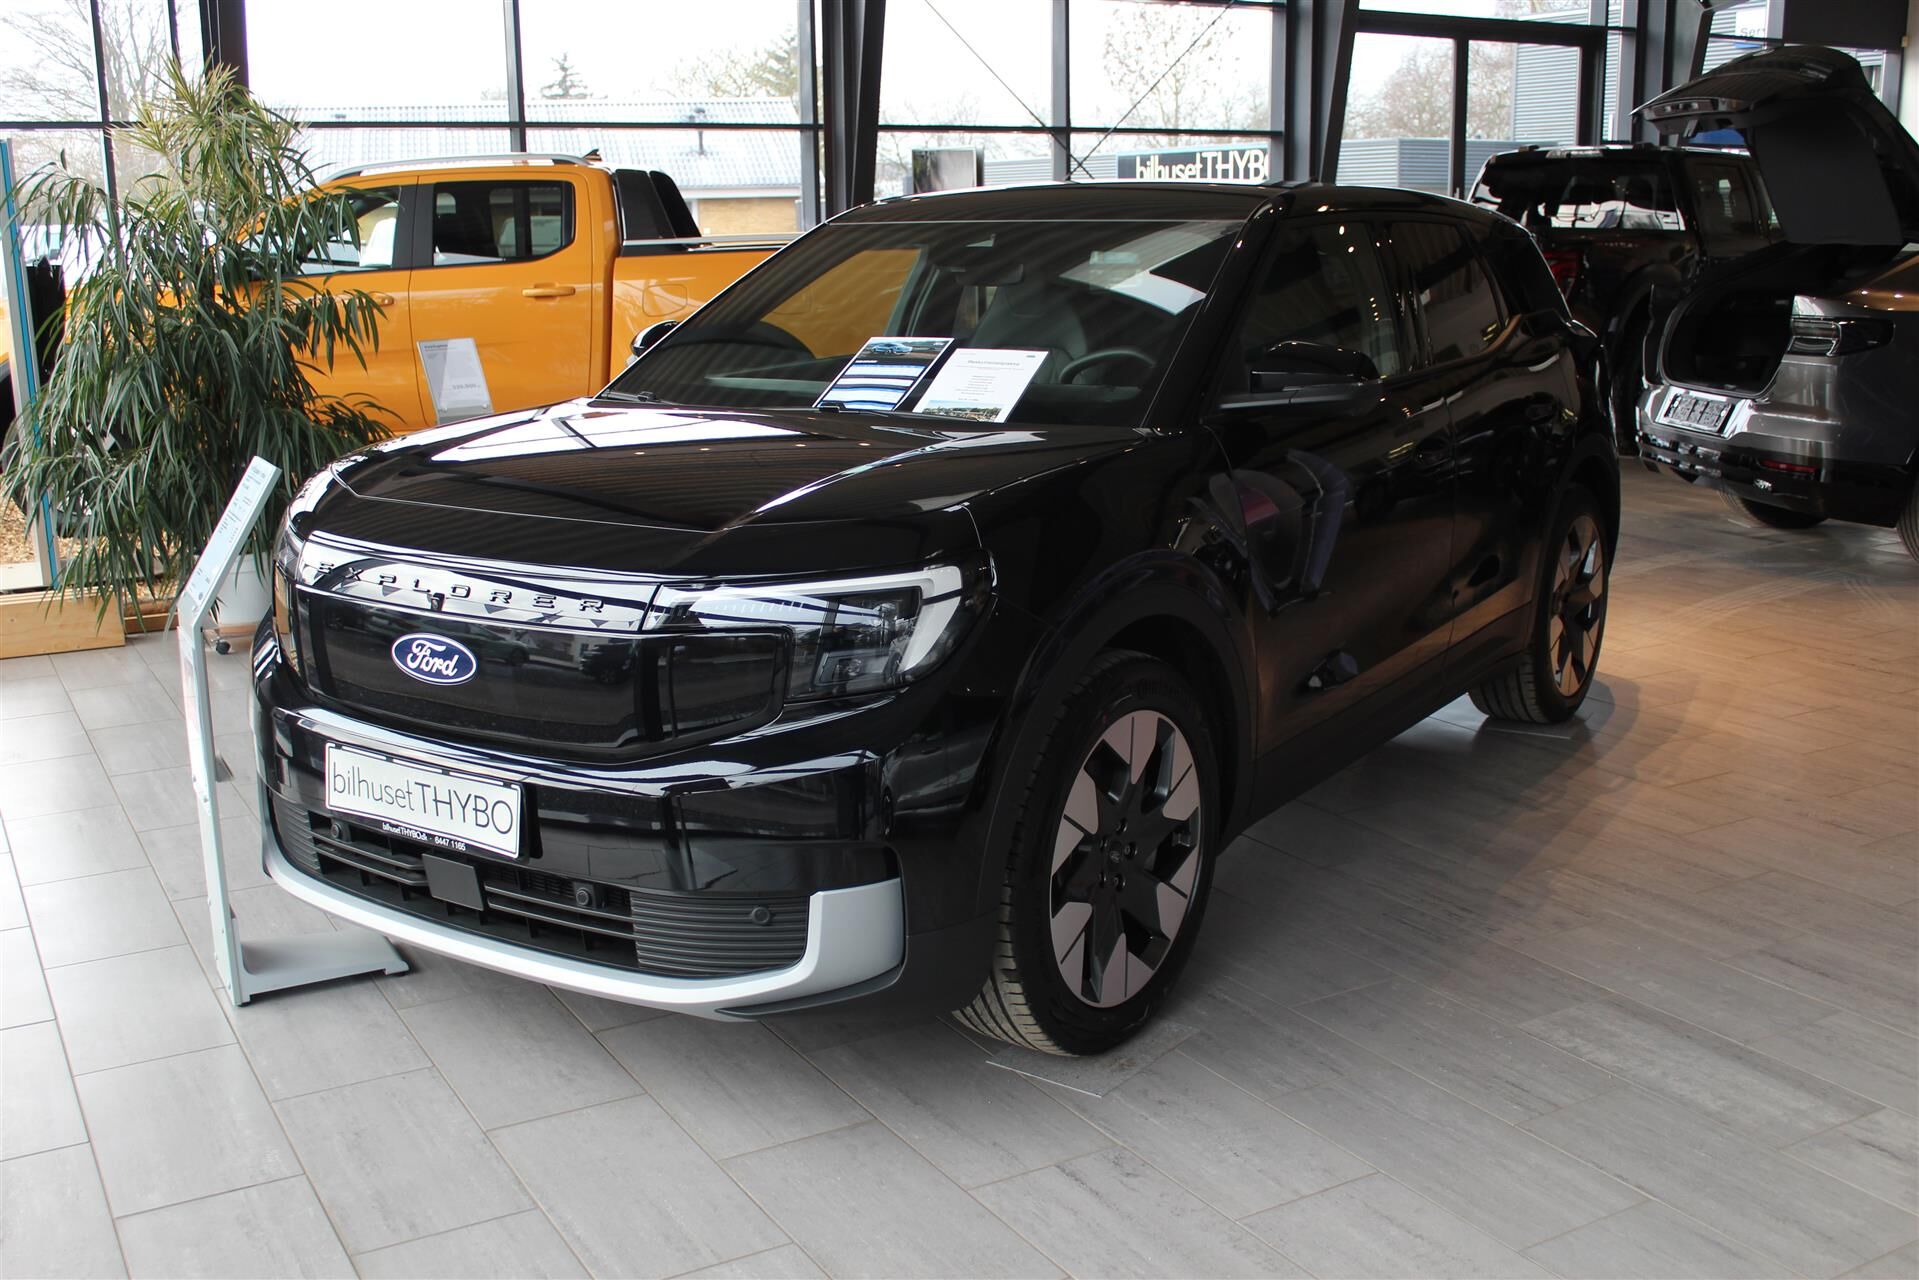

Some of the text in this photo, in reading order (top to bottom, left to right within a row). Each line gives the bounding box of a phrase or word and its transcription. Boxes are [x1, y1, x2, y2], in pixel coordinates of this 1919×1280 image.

[1136, 149, 1269, 180] bilhusetTHYB
[318, 561, 604, 613] EXPLORER
[407, 639, 459, 677] Ford
[333, 761, 514, 835] bilhusetTHYBO
[434, 836, 449, 846] 6447
